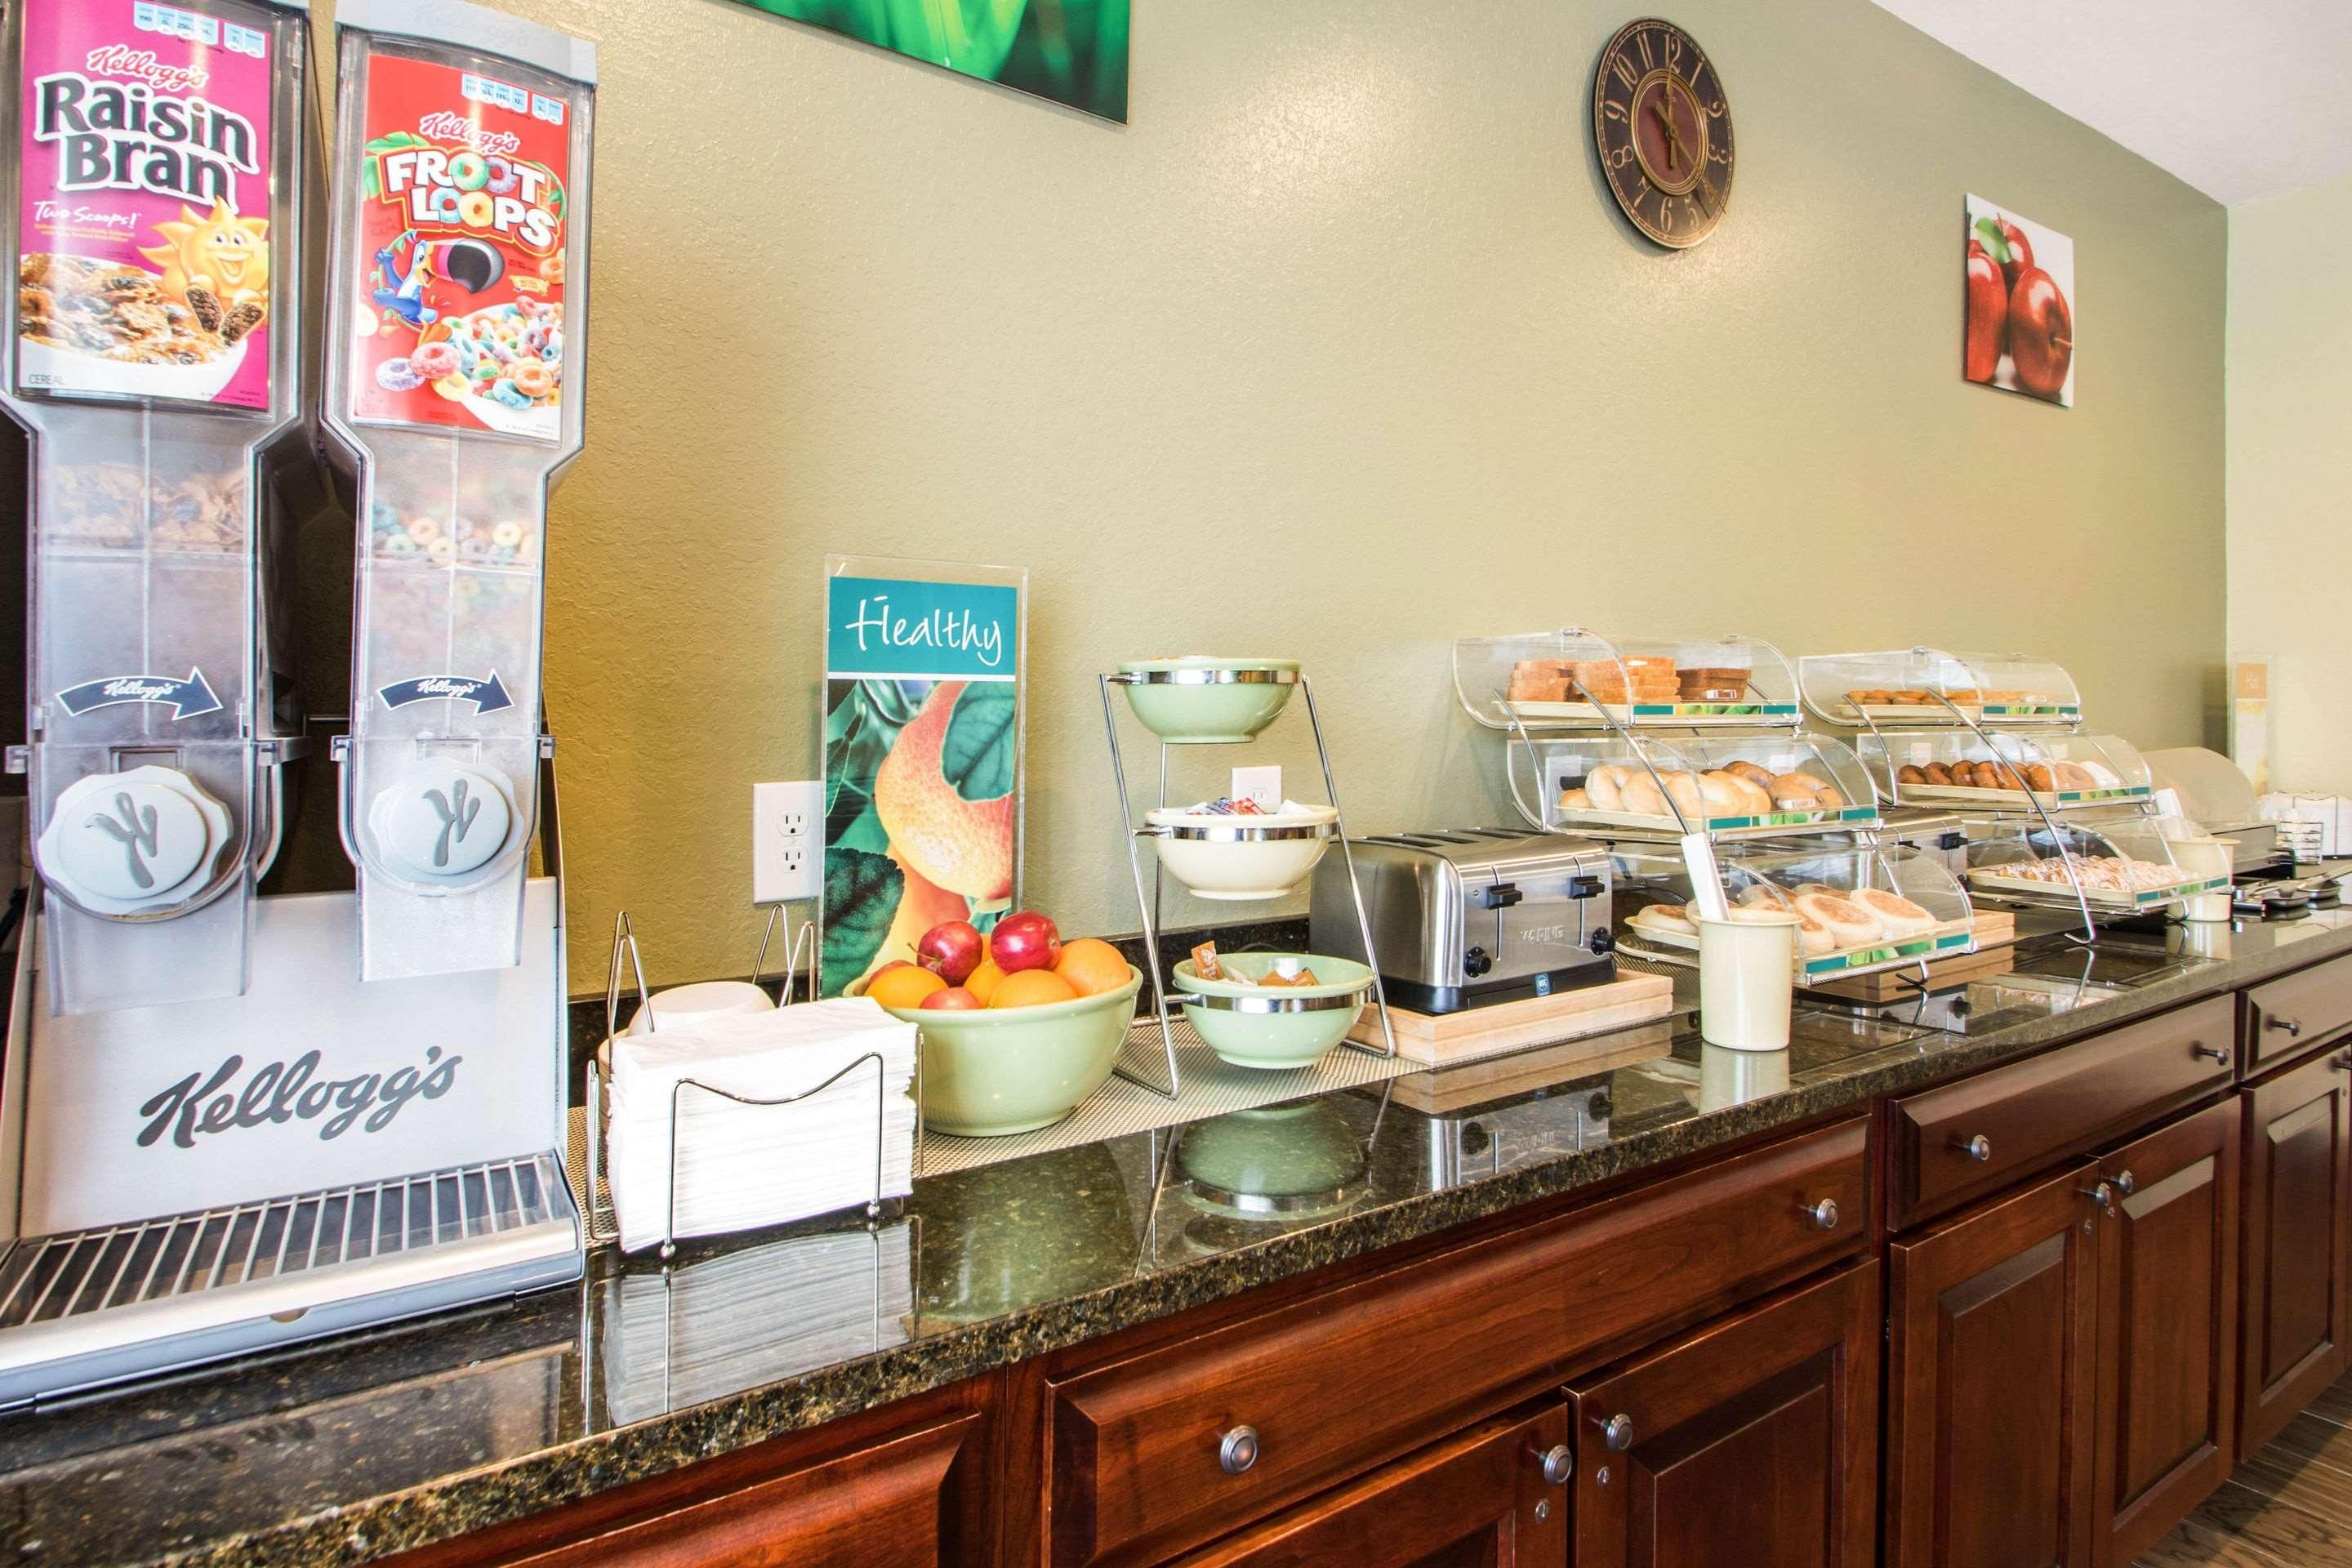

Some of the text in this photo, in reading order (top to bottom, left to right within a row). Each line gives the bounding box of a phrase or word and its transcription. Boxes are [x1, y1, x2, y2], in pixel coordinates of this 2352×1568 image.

[88, 47, 207, 89] Kellogg's
[1664, 32, 1681, 74] 12
[38, 76, 254, 169] Raisin
[422, 114, 518, 151] Kellogg's
[64, 132, 229, 203] Bran
[1610, 144, 1634, 169] 8
[1708, 143, 1729, 165] 3
[385, 149, 546, 204] FROOT
[1634, 176, 1652, 207] 7
[33, 200, 70, 222] Two
[410, 186, 556, 247] LOOPS
[29, 373, 66, 385] CEREAL
[844, 595, 1002, 667] Healthy
[104, 679, 175, 700] Kellogg's
[417, 677, 477, 698] Kellogg's
[136, 1045, 464, 1149] Kellogg's
